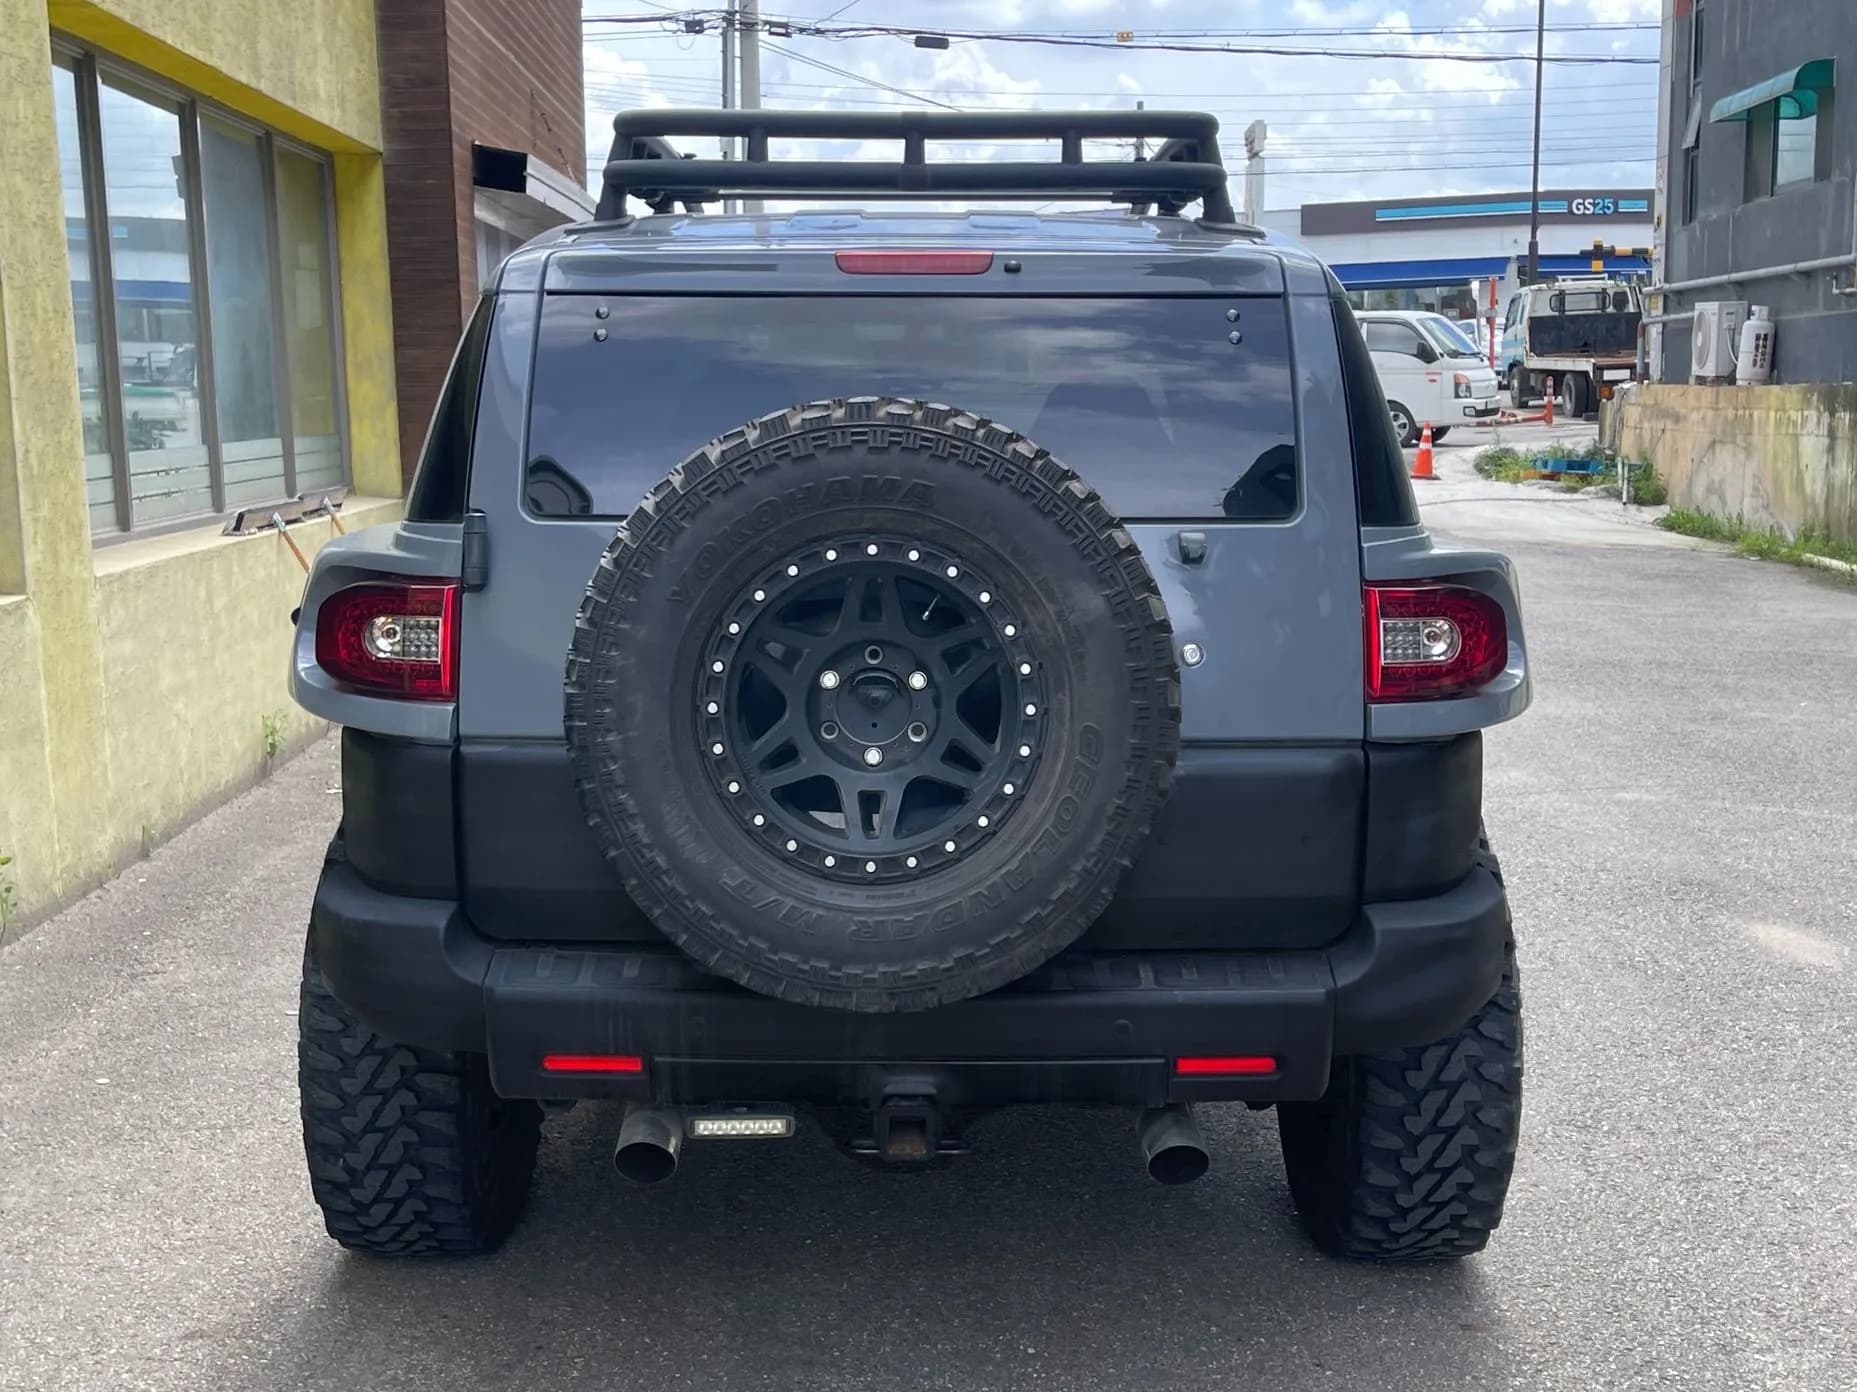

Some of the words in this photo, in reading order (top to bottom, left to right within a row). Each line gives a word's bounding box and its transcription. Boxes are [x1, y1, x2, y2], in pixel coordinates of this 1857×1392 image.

[1572, 199, 1614, 214] GS25
[666, 474, 937, 602] YOKOHAMA
[847, 721, 1105, 943] GEOLANDAR
[719, 872, 823, 937] M/T
